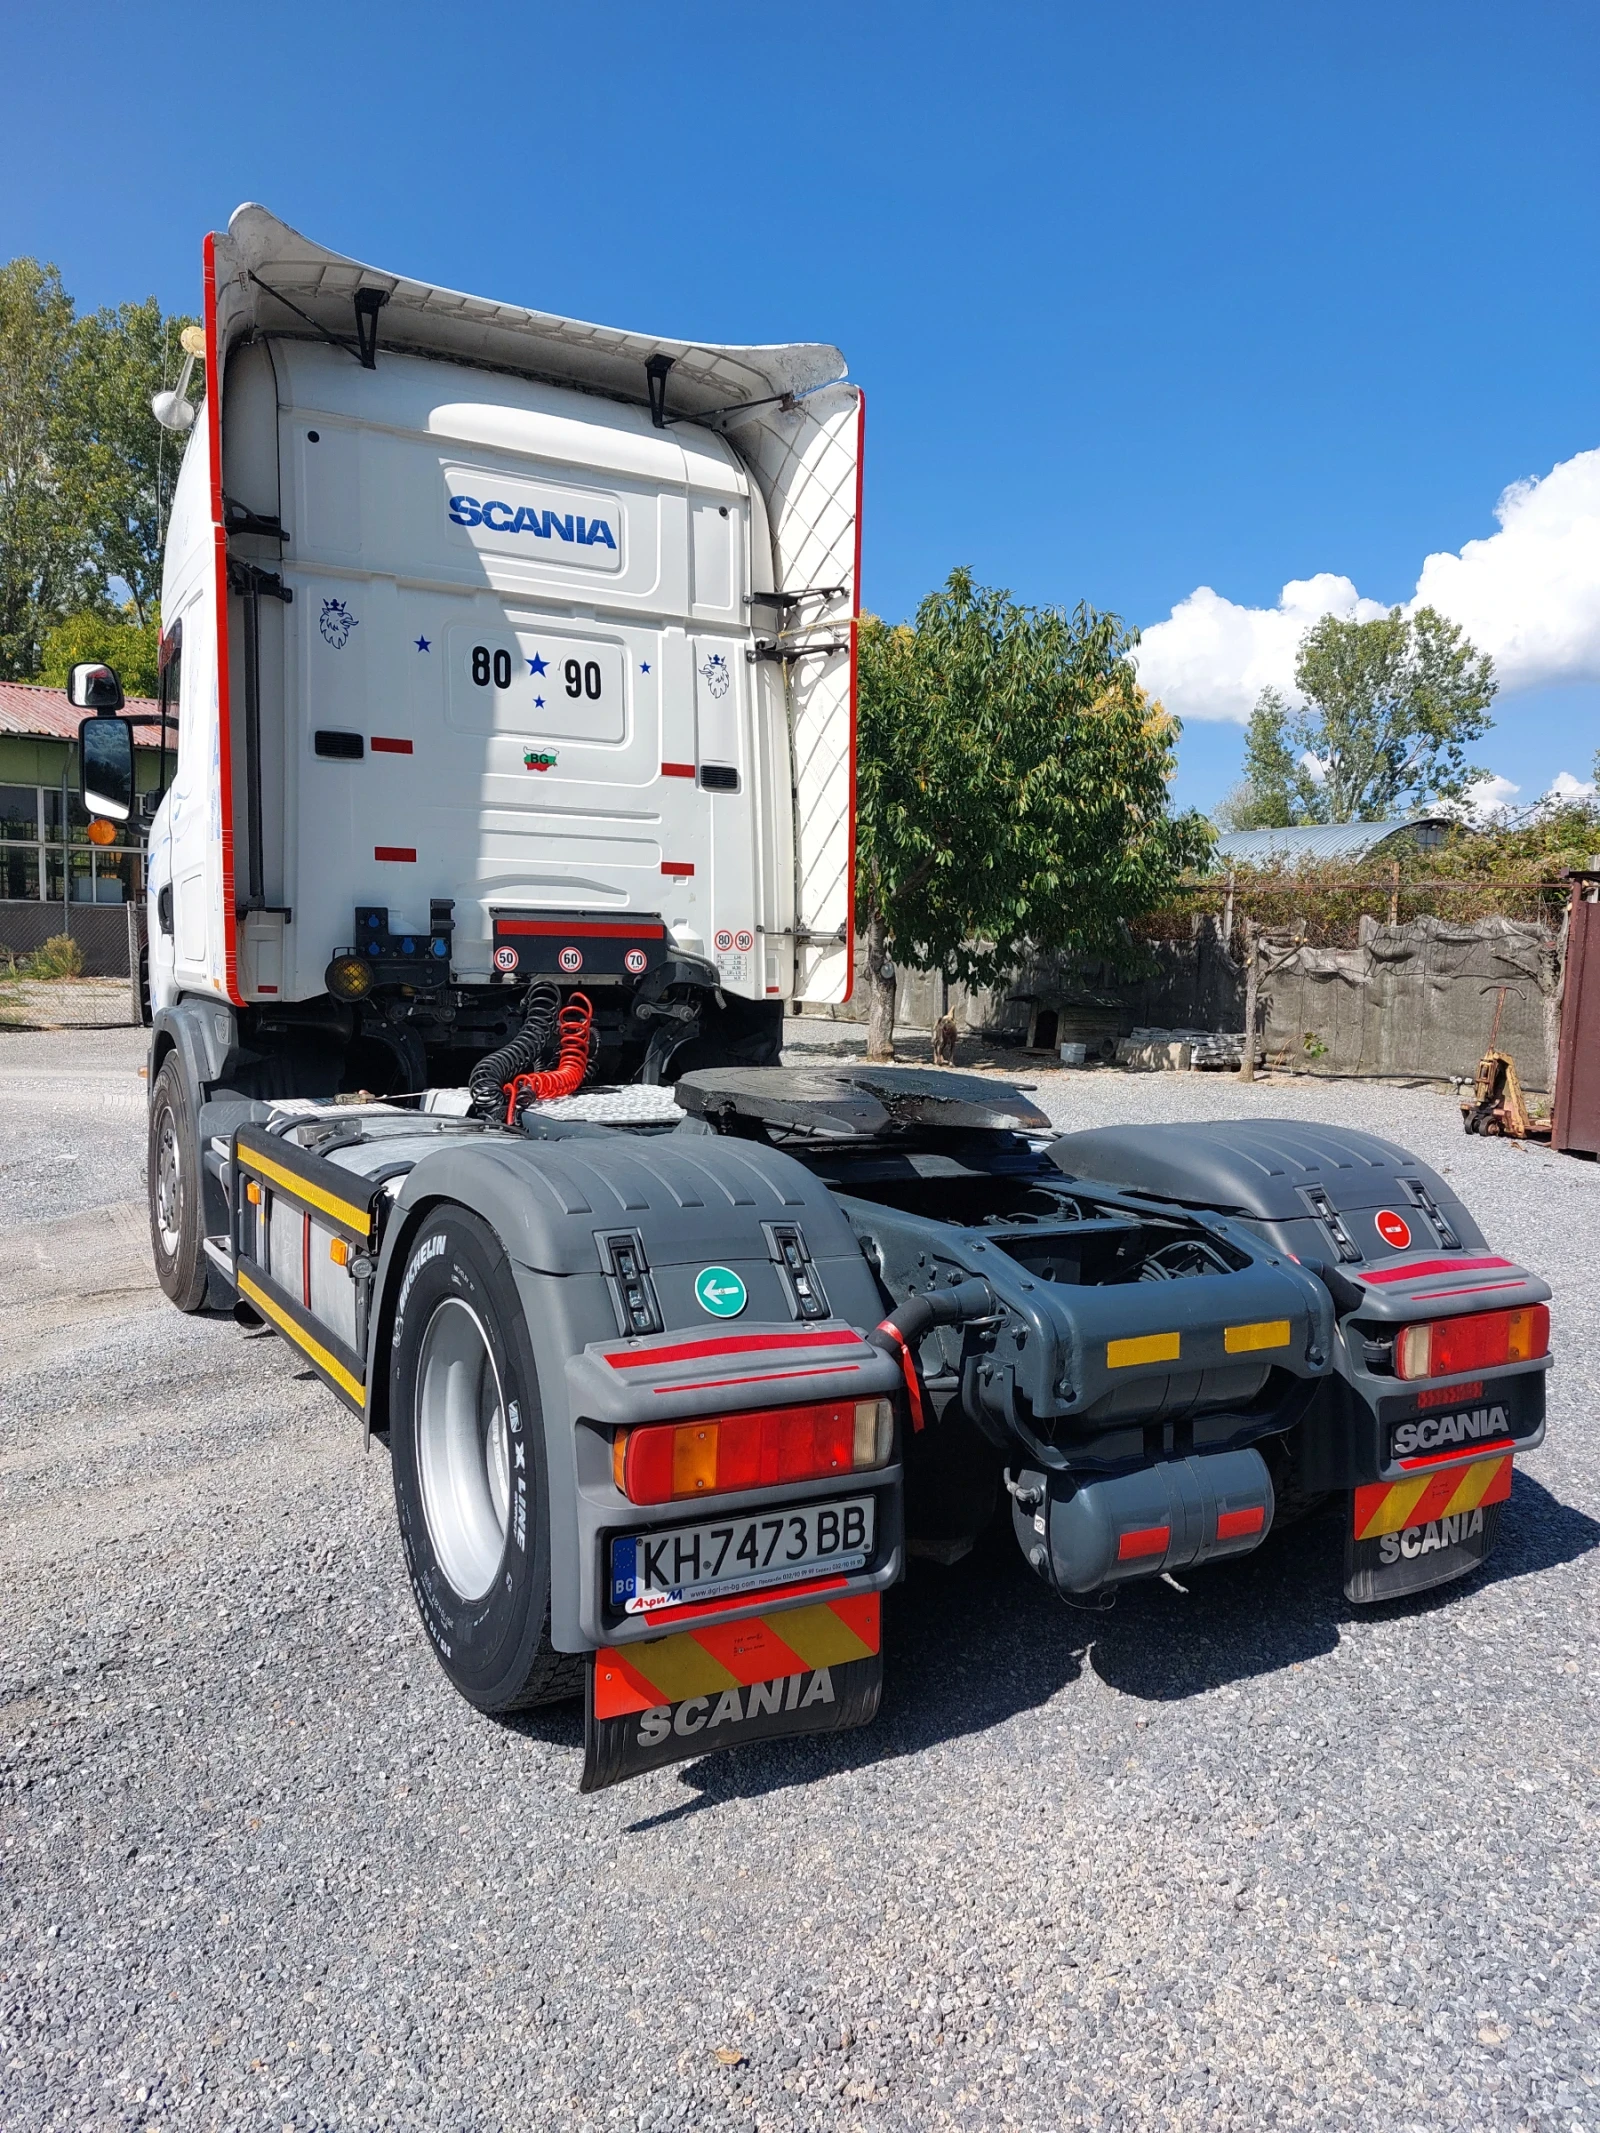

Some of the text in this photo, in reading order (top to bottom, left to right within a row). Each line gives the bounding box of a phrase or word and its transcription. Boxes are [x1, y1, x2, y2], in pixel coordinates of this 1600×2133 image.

[448, 495, 617, 550] SCANIA
[471, 645, 601, 700] 80 90
[530, 753, 549, 764] BG
[499, 952, 514, 964] 50
[563, 953, 578, 965] 60
[629, 955, 643, 966] 70
[718, 934, 730, 945] 80
[738, 935, 750, 946] 90
[400, 1235, 447, 1315] MICHELIN
[1395, 1406, 1510, 1454] SCANIA
[517, 1477, 527, 1553] LINE
[1379, 1507, 1484, 1564] SCANIA
[710, 1517, 807, 1577] 7473
[615, 1578, 635, 1594] BG
[637, 1667, 836, 1747] SCANIA
